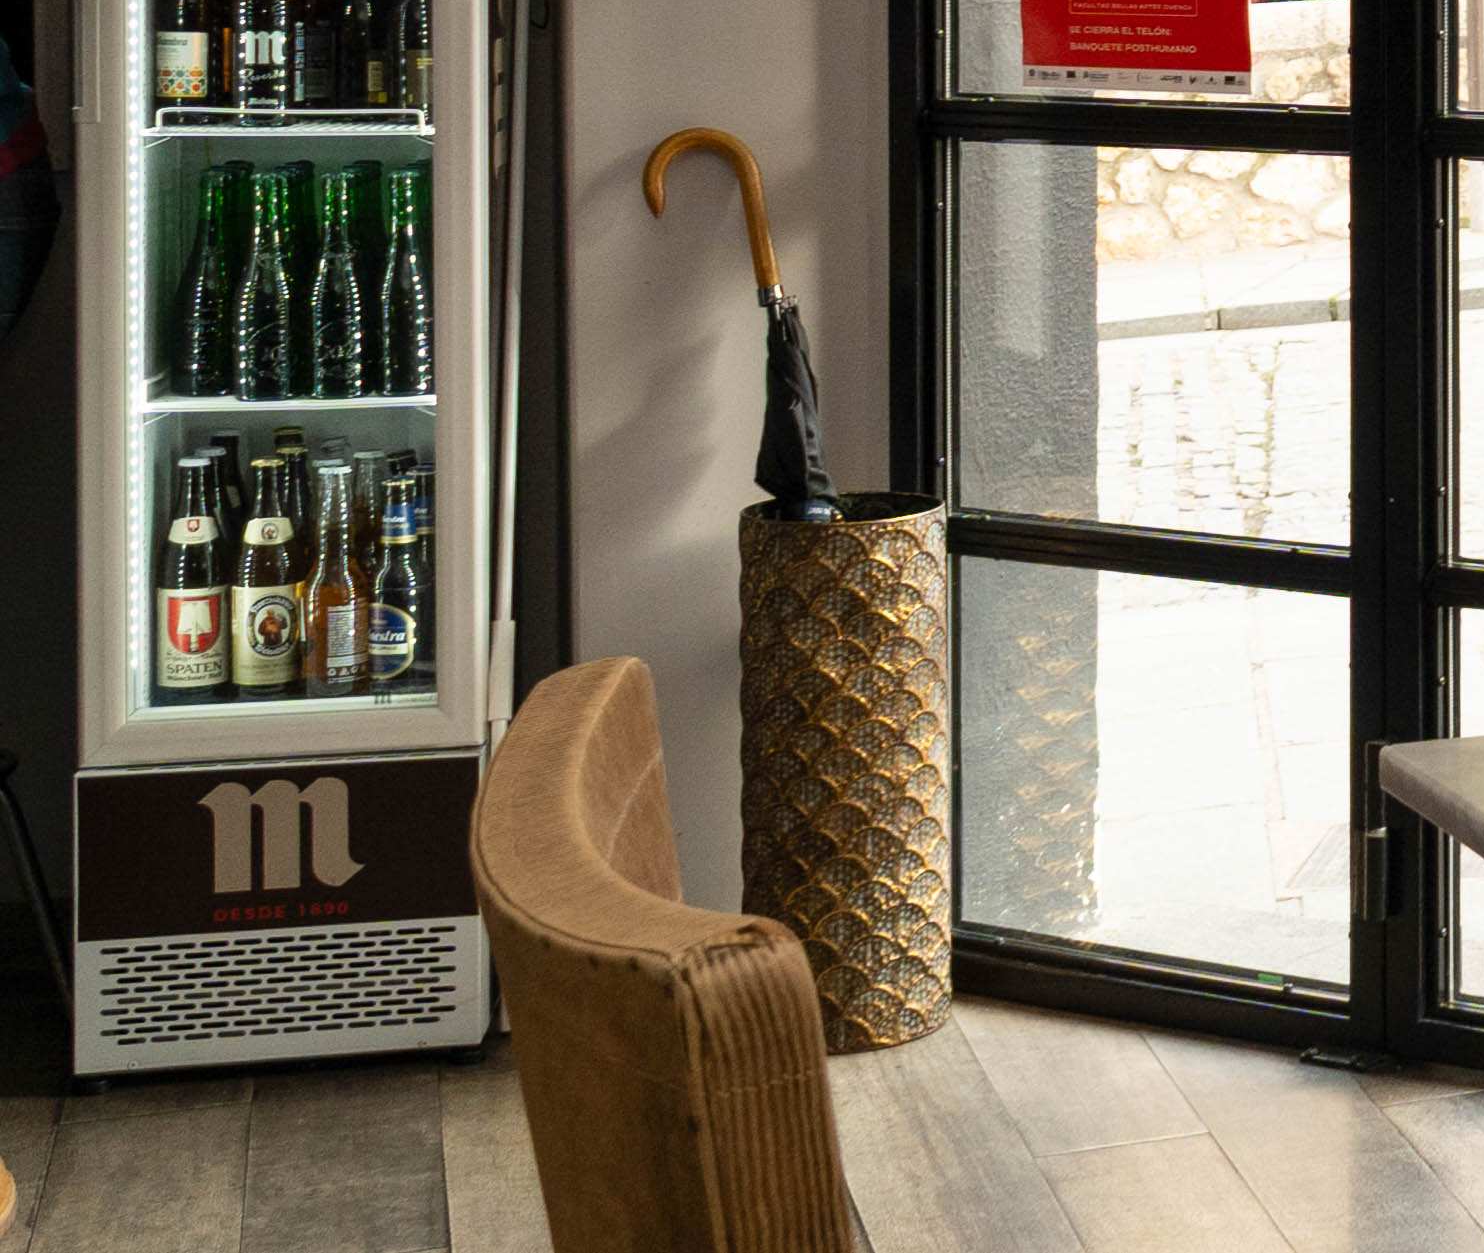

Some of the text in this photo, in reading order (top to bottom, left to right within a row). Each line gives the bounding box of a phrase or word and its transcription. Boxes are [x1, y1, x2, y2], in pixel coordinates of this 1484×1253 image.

[1083, 25, 1121, 36] CIERRA
[1121, 26, 1135, 36] EL
[1069, 42, 1198, 54] BANQUETE POSTHUMANO
[166, 661, 223, 675] SPATEN
[196, 776, 367, 894] m
[213, 904, 287, 923] DESDE
